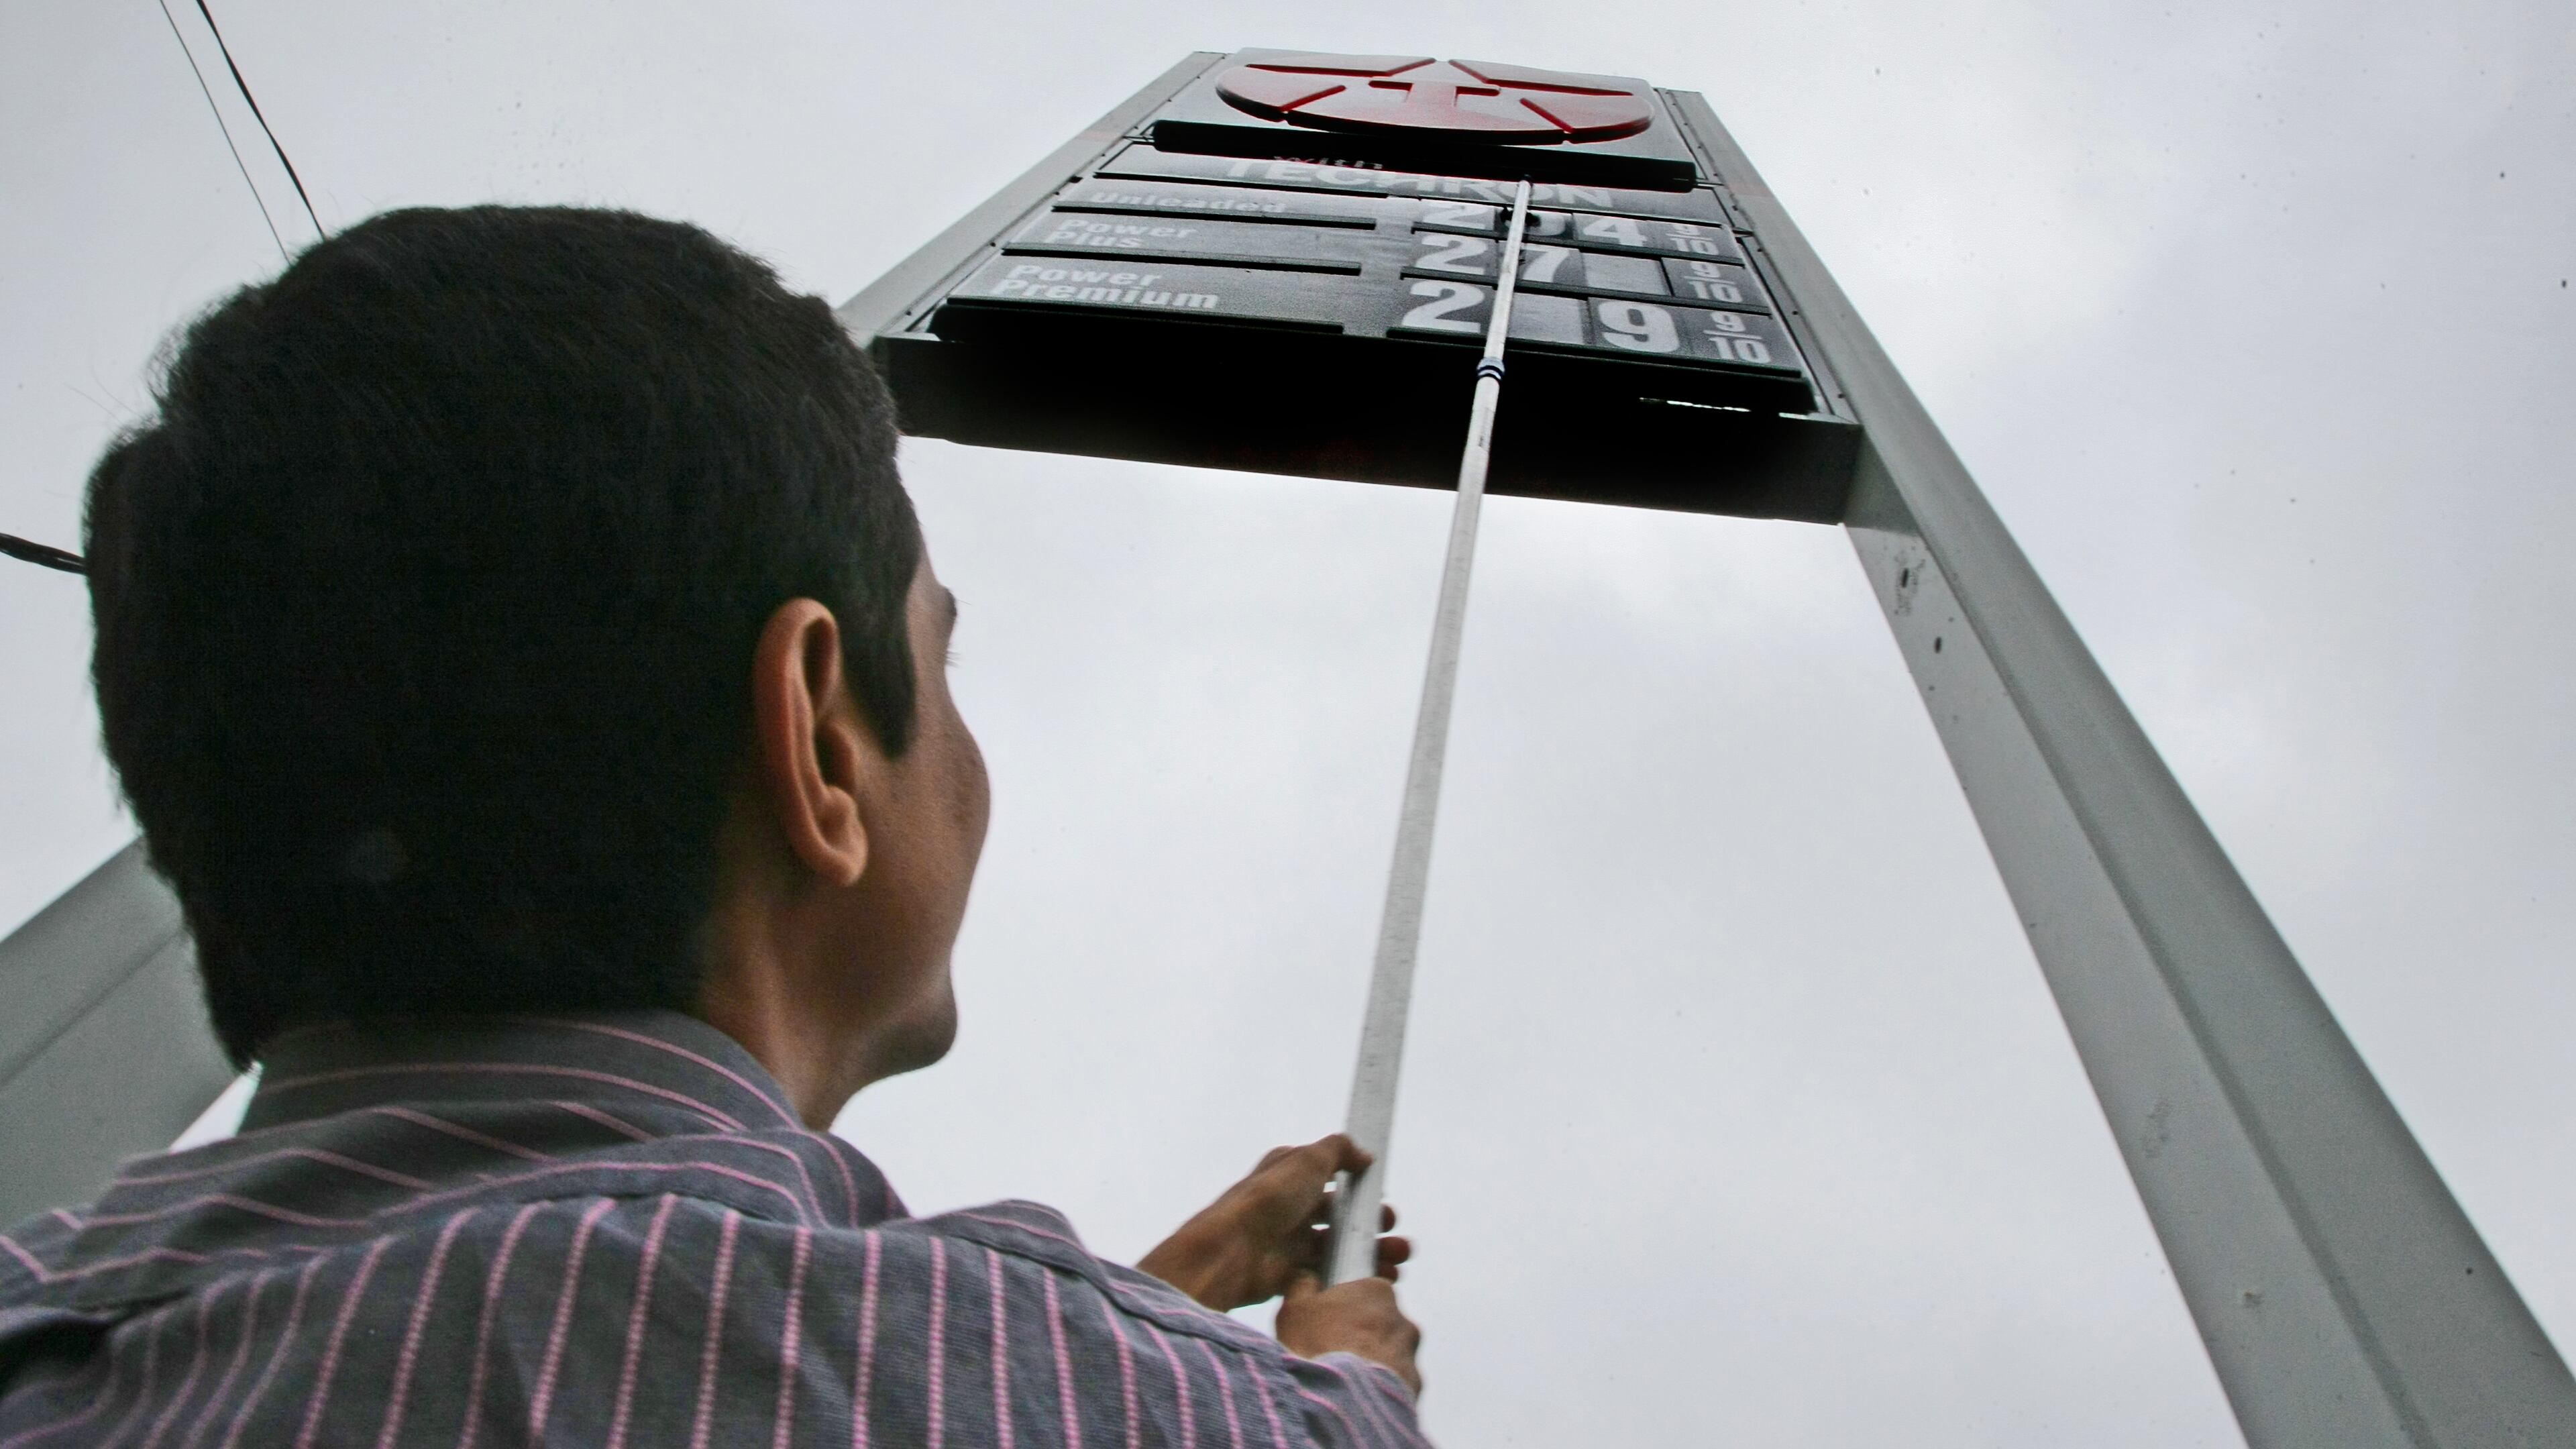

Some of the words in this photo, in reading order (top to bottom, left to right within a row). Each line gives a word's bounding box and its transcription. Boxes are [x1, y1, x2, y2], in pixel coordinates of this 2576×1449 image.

[1089, 192, 1287, 213] Unleaded
[1057, 219, 1198, 238] Power
[1044, 231, 1144, 249] Plus
[1007, 264, 1163, 286] Power
[989, 278, 1219, 309] Premium
